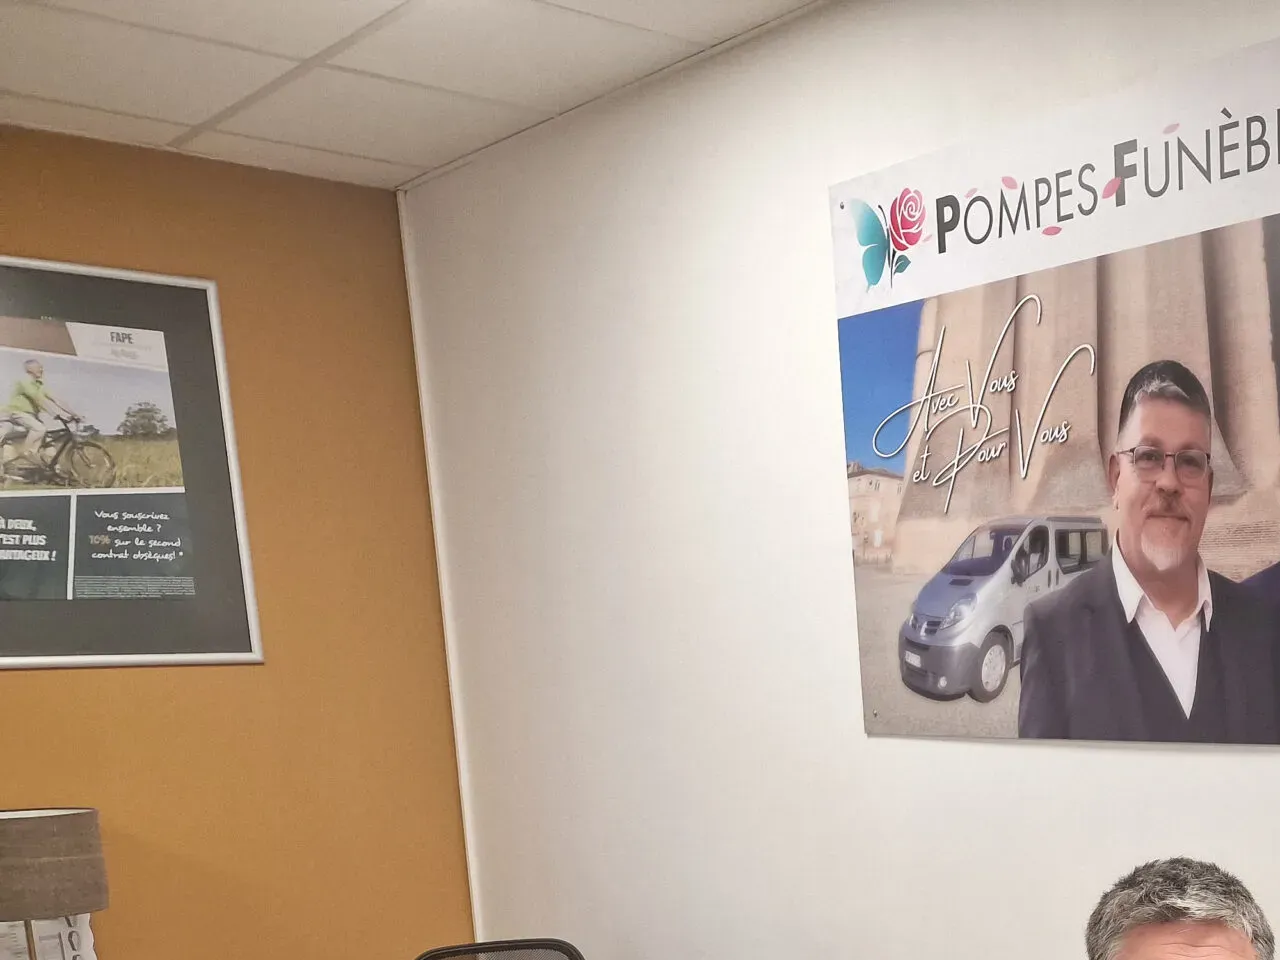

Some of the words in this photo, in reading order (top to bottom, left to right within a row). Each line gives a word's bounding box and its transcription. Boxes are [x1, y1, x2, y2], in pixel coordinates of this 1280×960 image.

[936, 163, 1098, 254] POMPES
[110, 331, 134, 345] FAPE
[873, 325, 964, 457] Avec
[966, 294, 1042, 428] Vous
[912, 444, 930, 483] et
[926, 403, 1010, 514] Pour
[1015, 343, 1096, 480] Vous
[22, 534, 47, 546] PLUS
[95, 510, 119, 520] Vous
